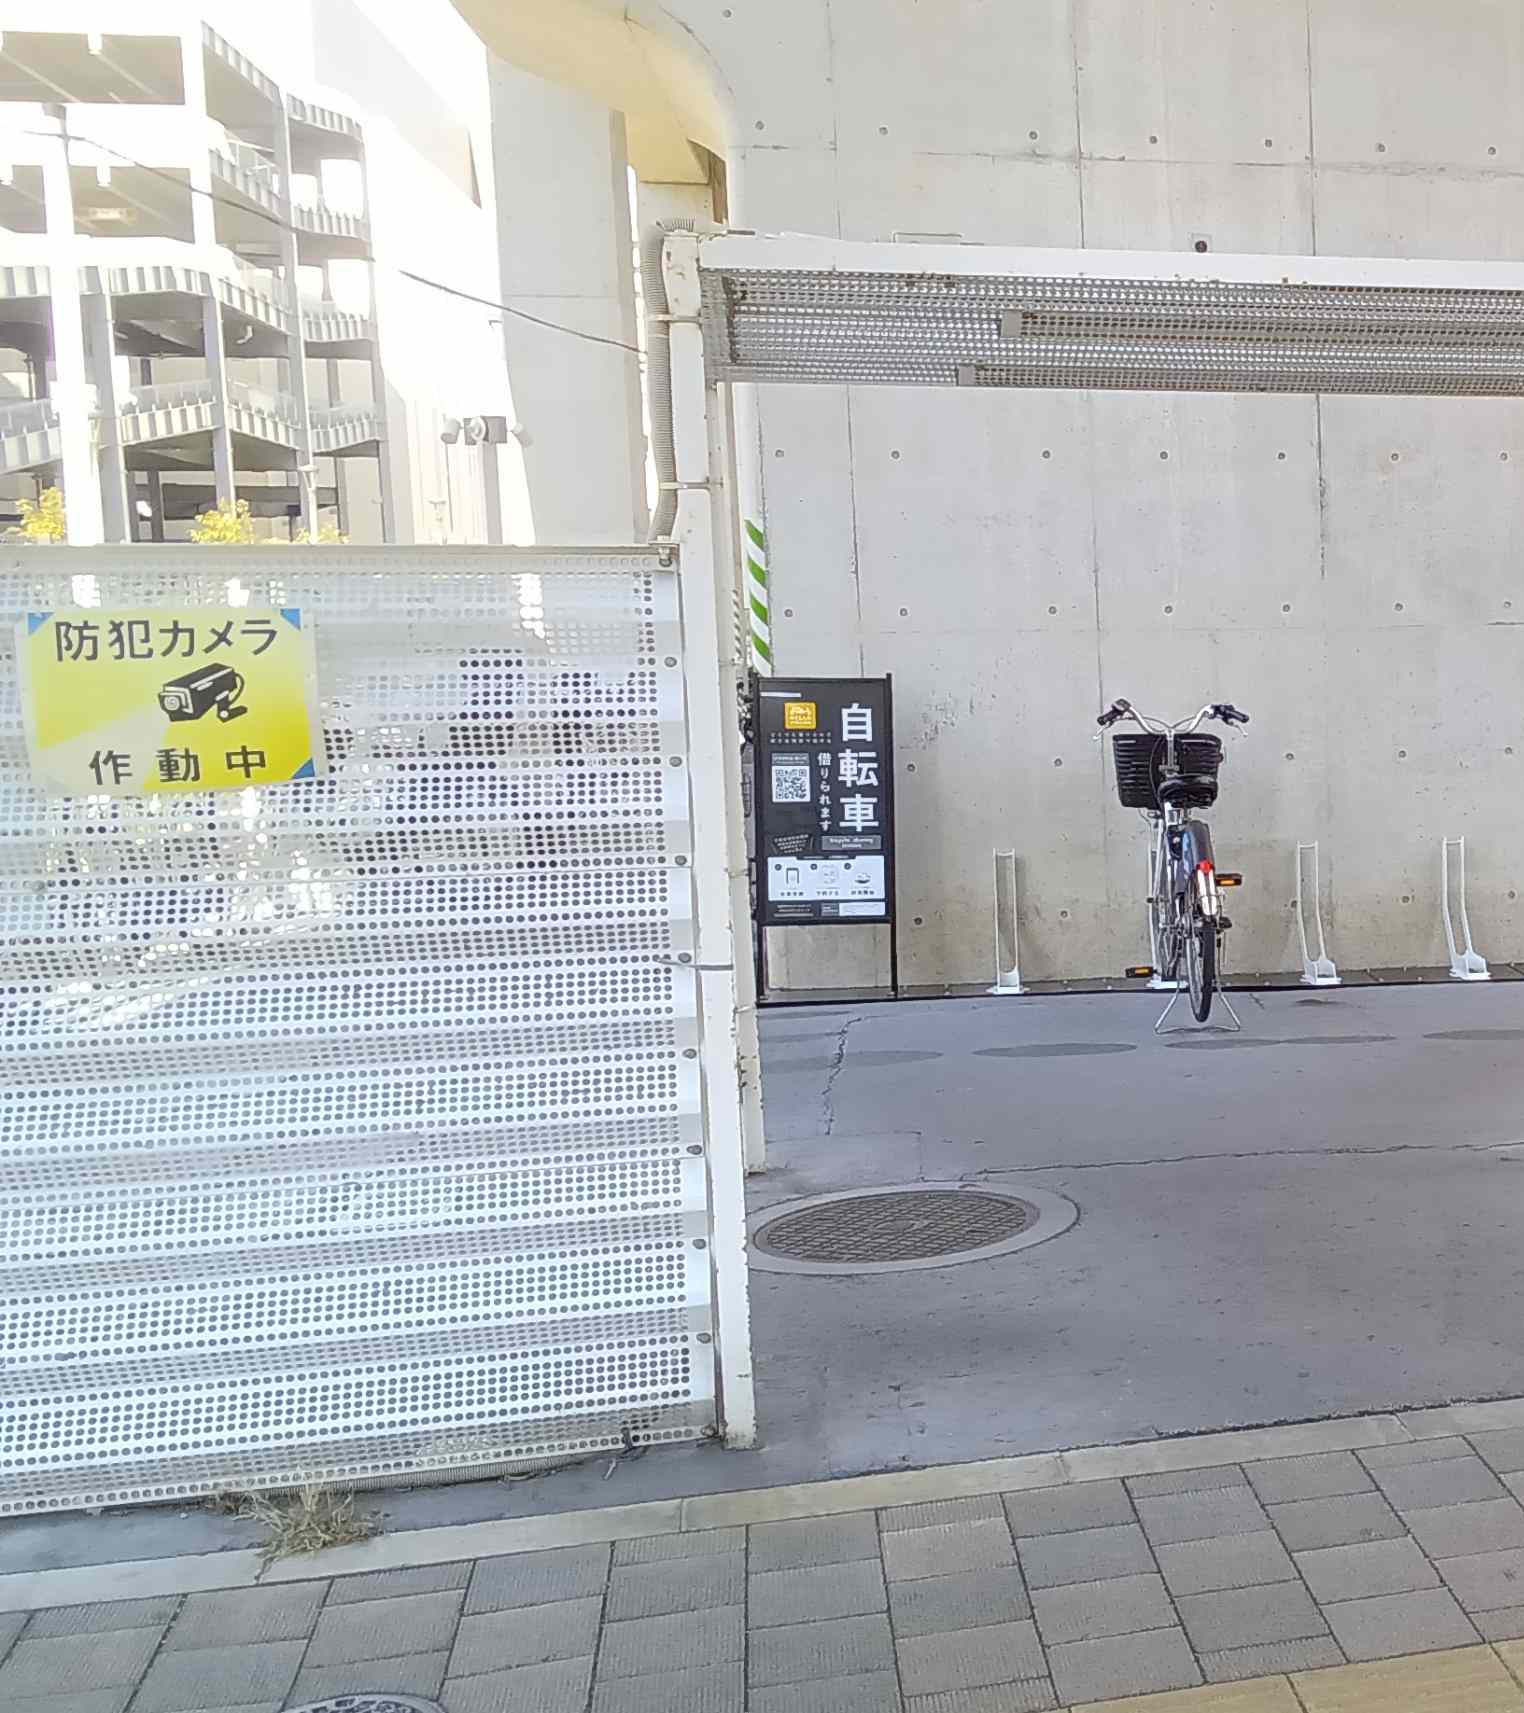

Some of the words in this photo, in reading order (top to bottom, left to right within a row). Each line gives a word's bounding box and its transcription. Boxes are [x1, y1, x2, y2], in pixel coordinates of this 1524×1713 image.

[55, 619, 278, 662] 防犯カメラ
[89, 745, 267, 785] 作動中
[817, 752, 832, 831] 借りられます
[838, 703, 879, 832] 自転車
